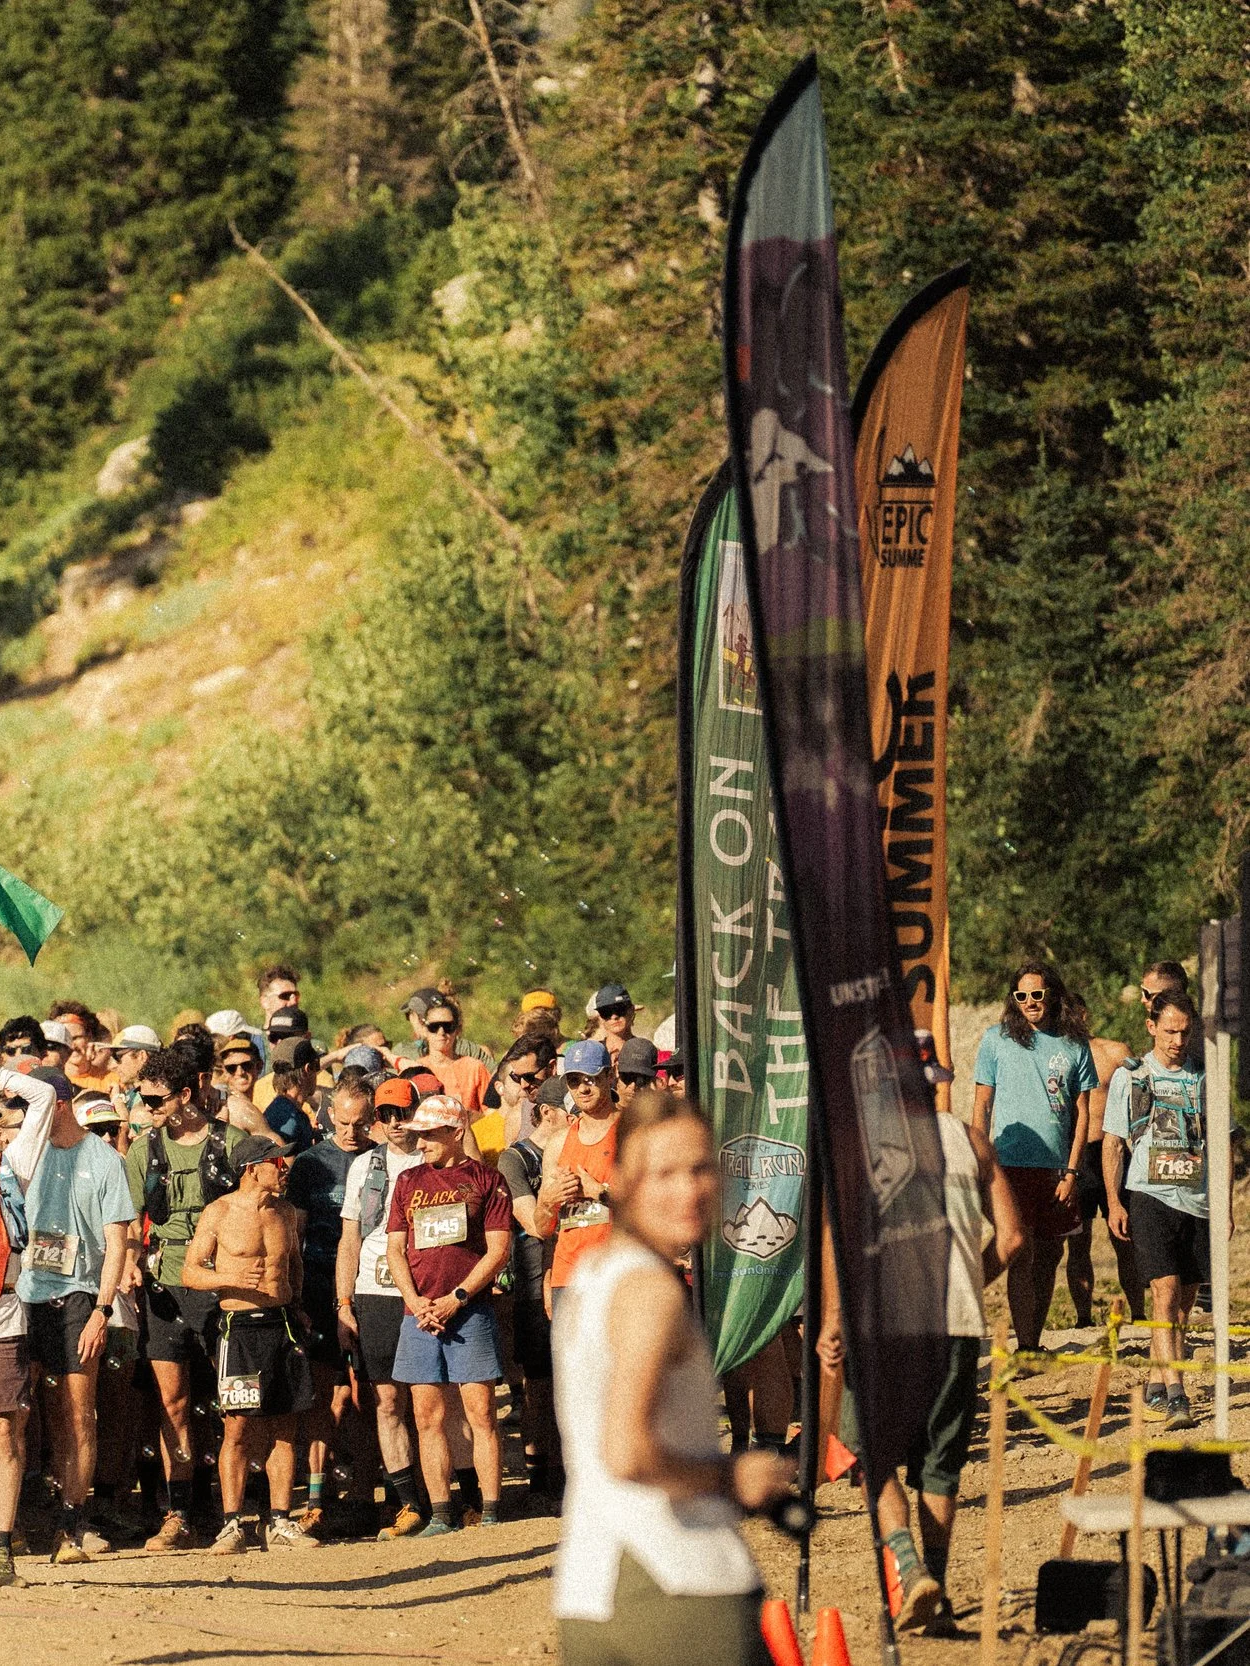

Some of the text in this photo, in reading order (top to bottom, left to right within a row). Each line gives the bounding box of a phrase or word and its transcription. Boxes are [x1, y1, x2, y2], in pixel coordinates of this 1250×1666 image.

[882, 506, 933, 544] EPIC
[880, 548, 925, 568] SUMME
[709, 755, 754, 1094] BACK ON
[721, 1149, 806, 1179] TRAIL RUN
[1156, 1159, 1193, 1175] 7183
[410, 1189, 459, 1207] BLACK
[421, 1217, 460, 1237] 7145
[34, 1244, 68, 1263] 7121
[221, 1388, 260, 1404] 7088
